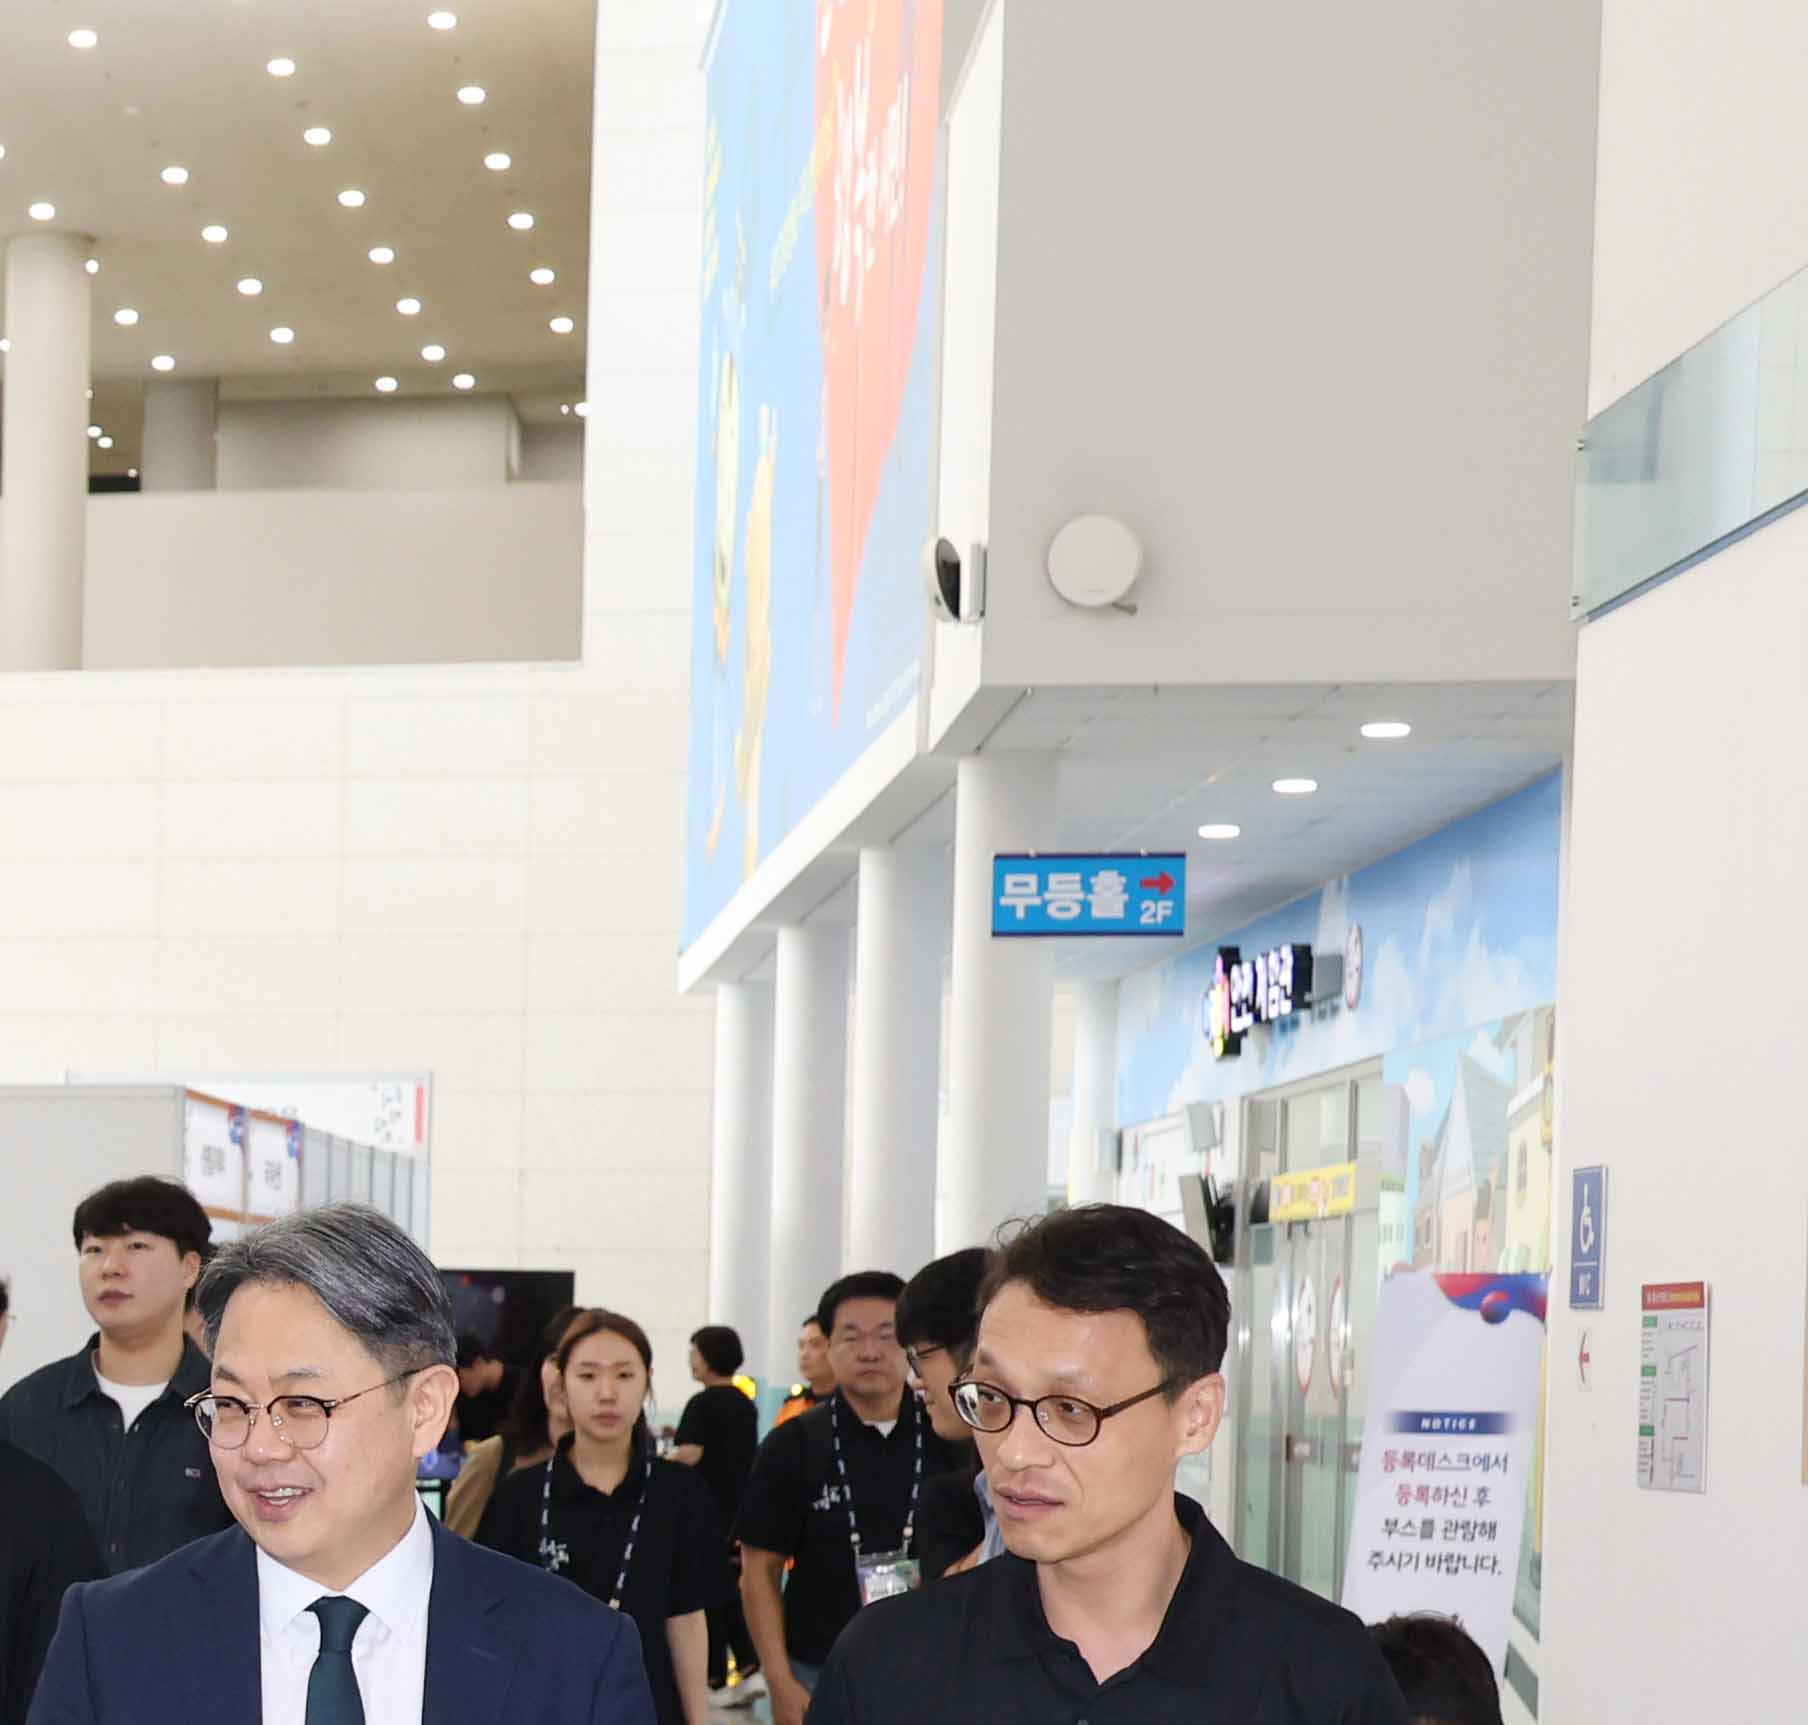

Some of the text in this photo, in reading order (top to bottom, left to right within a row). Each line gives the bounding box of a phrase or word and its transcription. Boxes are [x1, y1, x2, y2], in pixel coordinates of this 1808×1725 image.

[999, 869, 1129, 921] 무등홀
[1139, 899, 1174, 925] 2F
[1420, 1417, 1477, 1431] NOTICE
[1381, 1449, 1509, 1474] 등록데스크에서
[1396, 1483, 1492, 1508] 등록하신 후
[1382, 1517, 1497, 1542] 부스를 관람해
[1367, 1550, 1503, 1577] 주시기 바랍니다.
